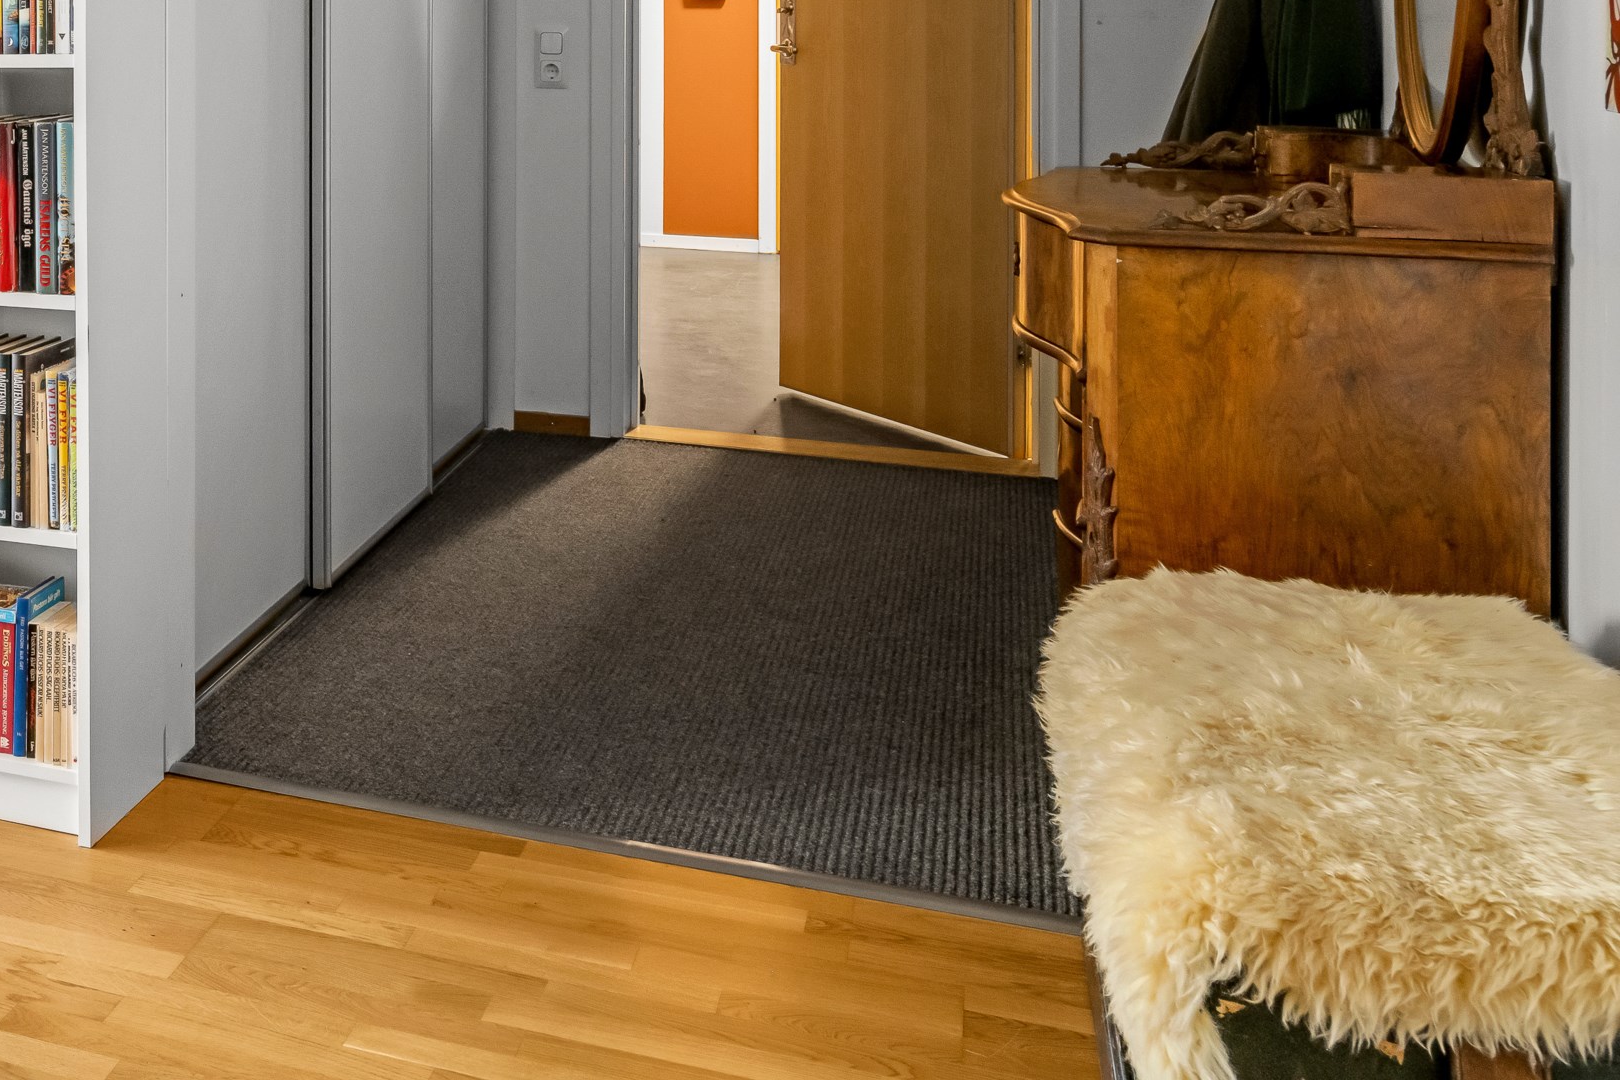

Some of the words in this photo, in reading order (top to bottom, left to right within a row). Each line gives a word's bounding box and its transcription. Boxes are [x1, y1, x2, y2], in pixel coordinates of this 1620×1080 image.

[41, 129, 49, 144] JAN
[13, 372, 27, 416] MÅRTENSON
[49, 387, 55, 399] VI
[59, 390, 66, 403] VI
[59, 411, 67, 444] FLYR
[2, 629, 10, 667] EDDINGS
